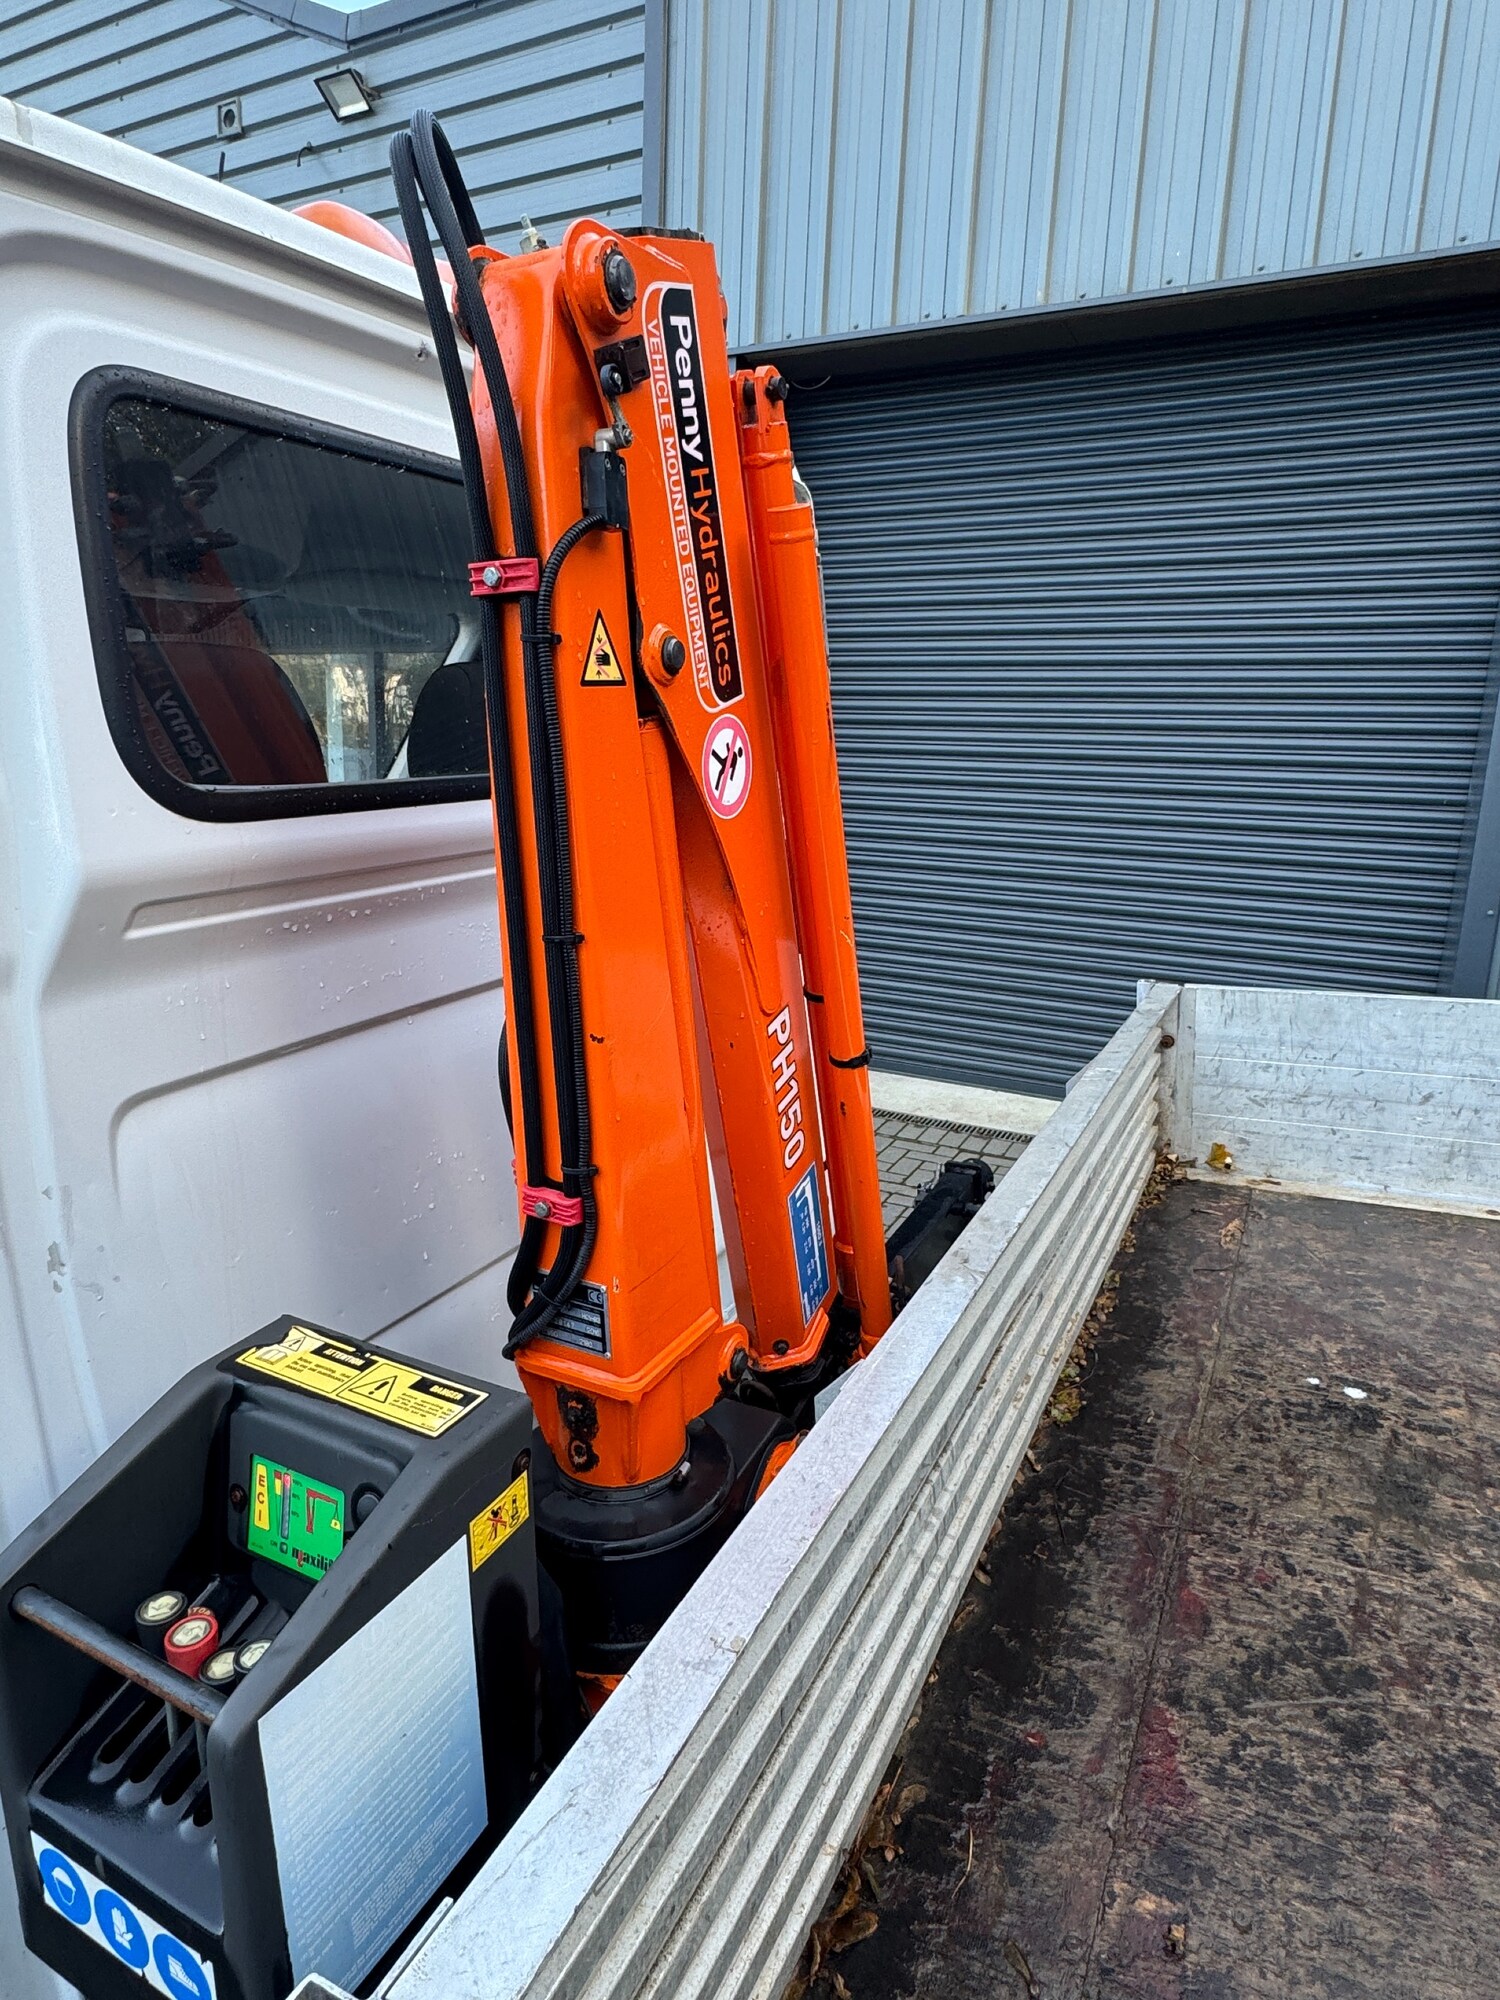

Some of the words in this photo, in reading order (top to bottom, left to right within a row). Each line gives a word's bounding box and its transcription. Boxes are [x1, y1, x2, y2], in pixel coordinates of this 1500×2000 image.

[647, 318, 673, 429] VEHICLE
[664, 438, 690, 556] MOUNTED
[682, 562, 710, 690] EQUIPMENT
[670, 315, 704, 462] Penny
[690, 467, 732, 686] Hydraulics
[768, 1006, 805, 1169] PH150
[322, 1348, 366, 1366] ATTENTION
[429, 1384, 465, 1401] DANGER
